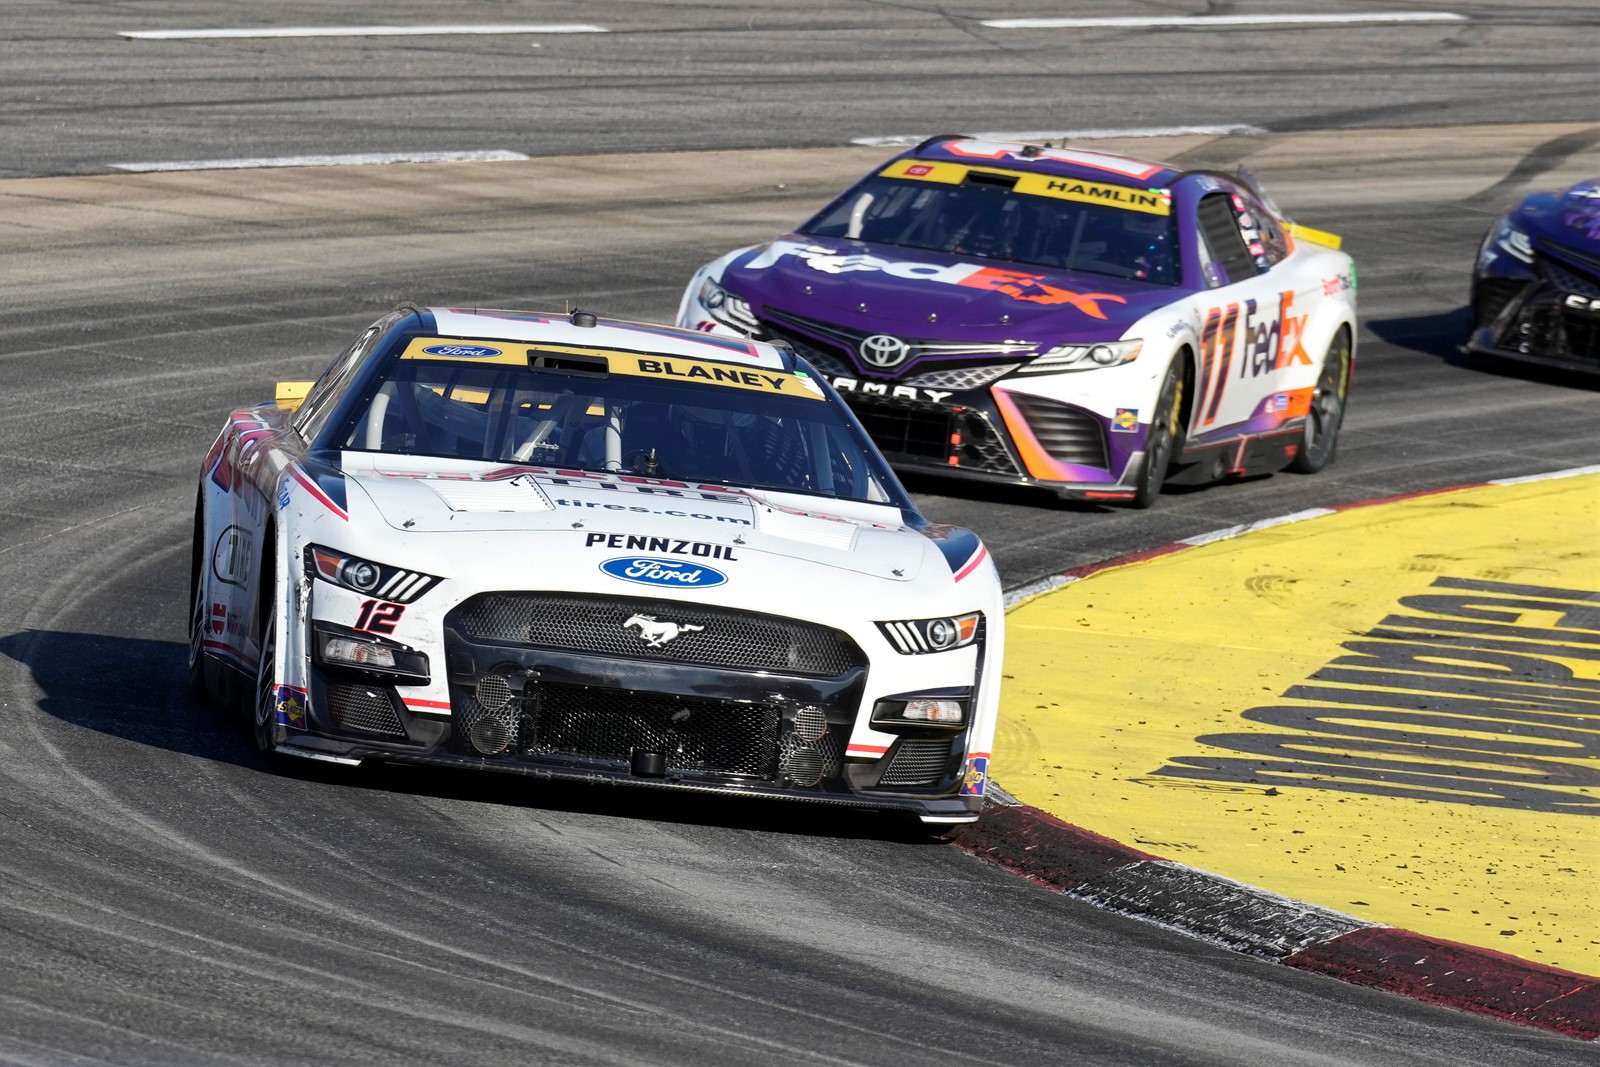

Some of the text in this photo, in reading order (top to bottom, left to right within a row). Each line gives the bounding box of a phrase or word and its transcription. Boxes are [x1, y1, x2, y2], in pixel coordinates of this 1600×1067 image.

[1046, 180, 1158, 208] HAMLIN
[1240, 290, 1313, 378] FedEx
[638, 359, 786, 391] BLANEY
[1194, 303, 1239, 430] 11
[824, 375, 954, 404] AMRY
[554, 498, 750, 526] tires.com
[585, 532, 739, 562] PENNZOIL
[624, 558, 701, 585] Ford
[352, 599, 407, 636] 12
